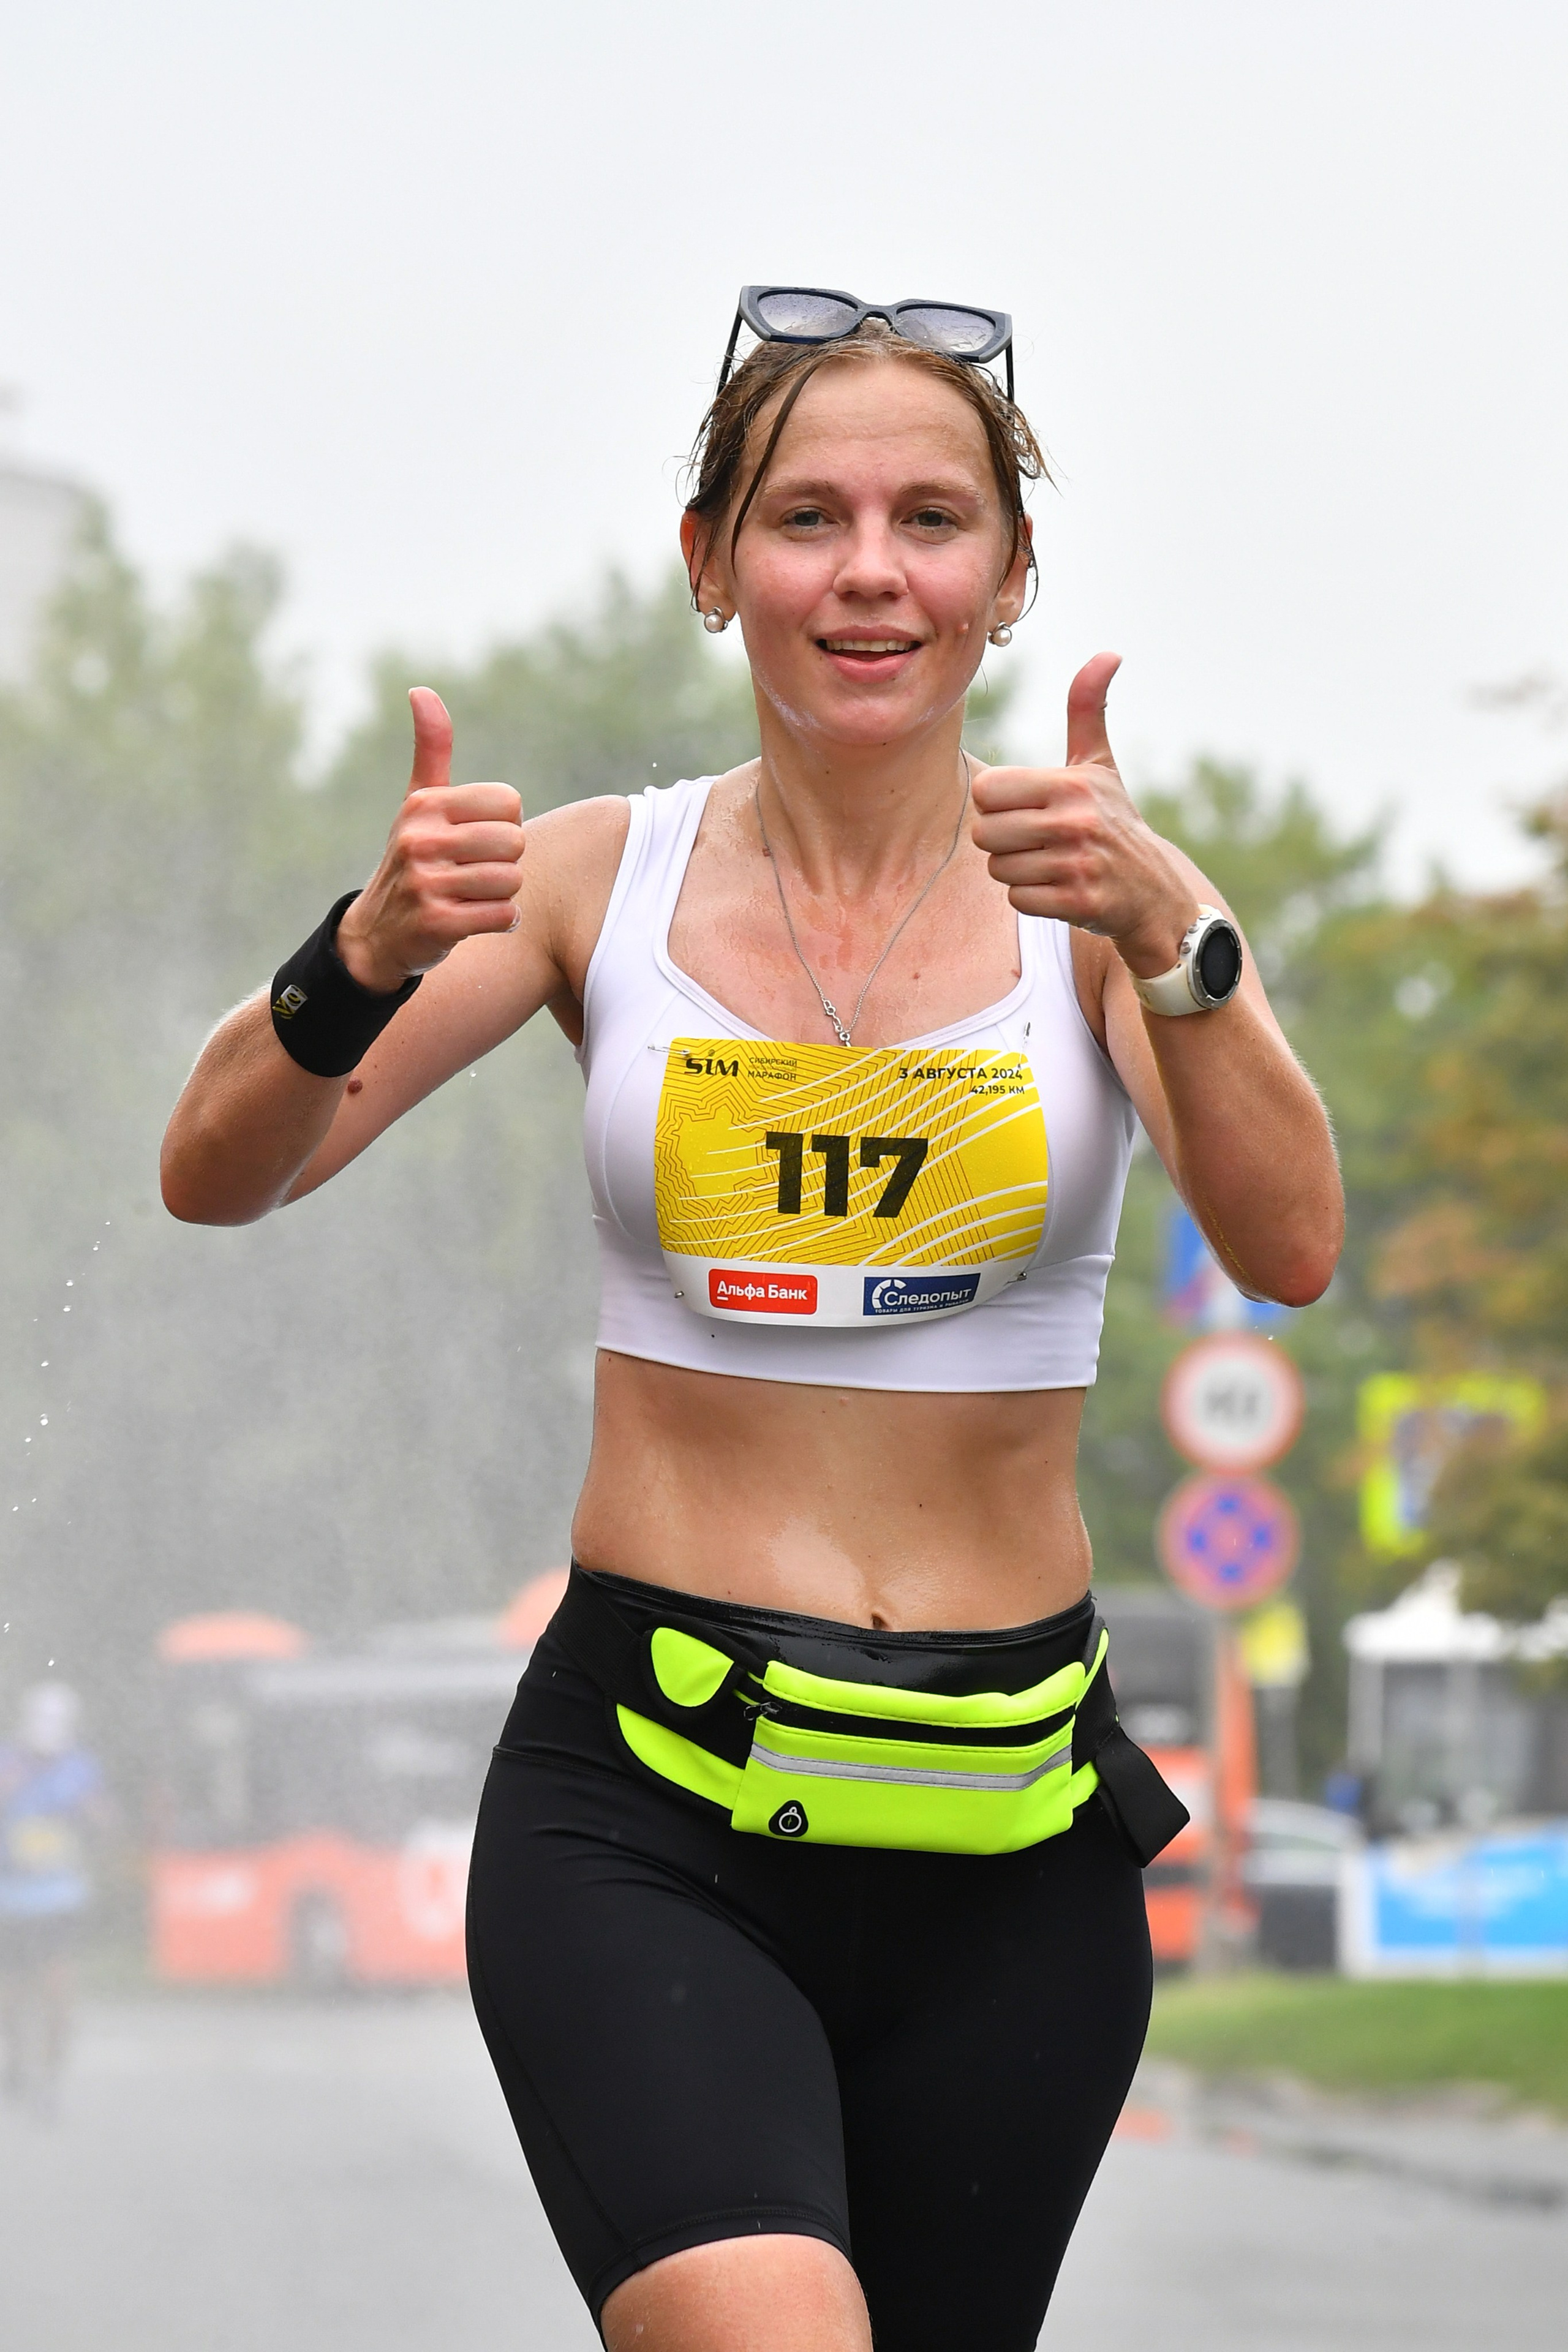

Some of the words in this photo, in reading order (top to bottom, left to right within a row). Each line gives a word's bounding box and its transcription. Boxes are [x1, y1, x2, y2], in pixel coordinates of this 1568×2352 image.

[747, 1070, 797, 1081] МАРАФОН
[899, 1068, 908, 1079] 3
[913, 1068, 987, 1079] АВГУСТА
[991, 1068, 1023, 1080] 2024
[970, 1085, 1006, 1095] 42,195
[1009, 1086, 1025, 1095] КМ
[765, 1131, 929, 1218] 117
[717, 1280, 766, 1301] Альфа
[767, 1284, 808, 1300] Банк
[884, 1288, 972, 1306] Следопыт
